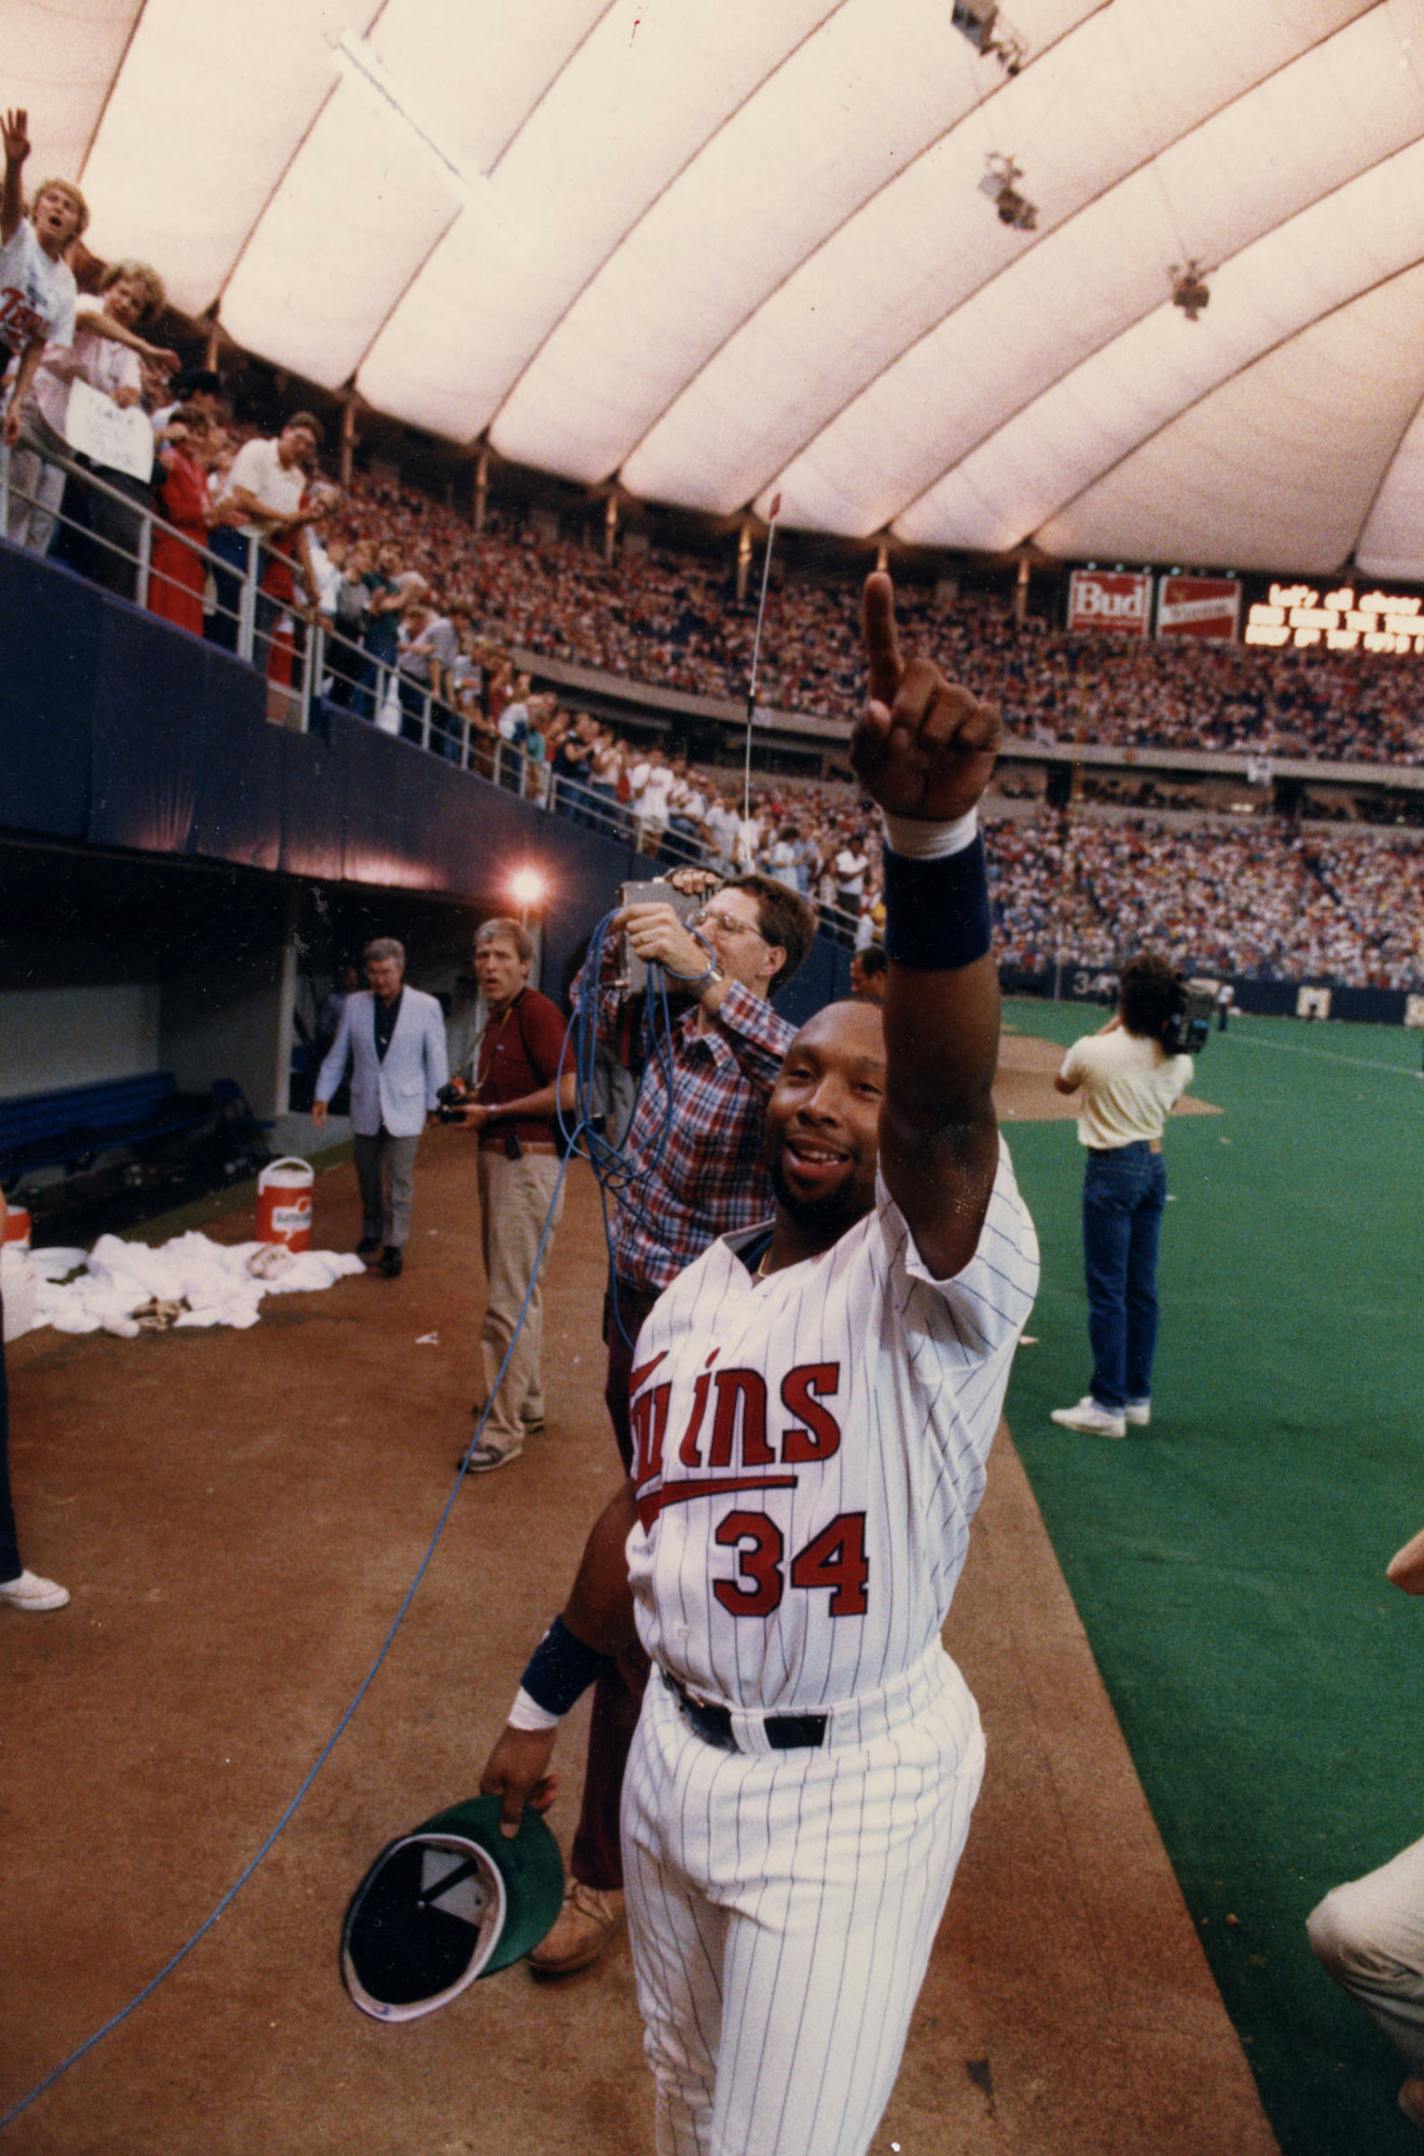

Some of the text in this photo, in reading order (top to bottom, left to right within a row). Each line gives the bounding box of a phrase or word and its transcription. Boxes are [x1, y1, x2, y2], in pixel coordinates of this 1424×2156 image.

[1077, 582, 1142, 617] Bud
[629, 1347, 841, 1490] wins
[712, 1510, 869, 1617] 34
